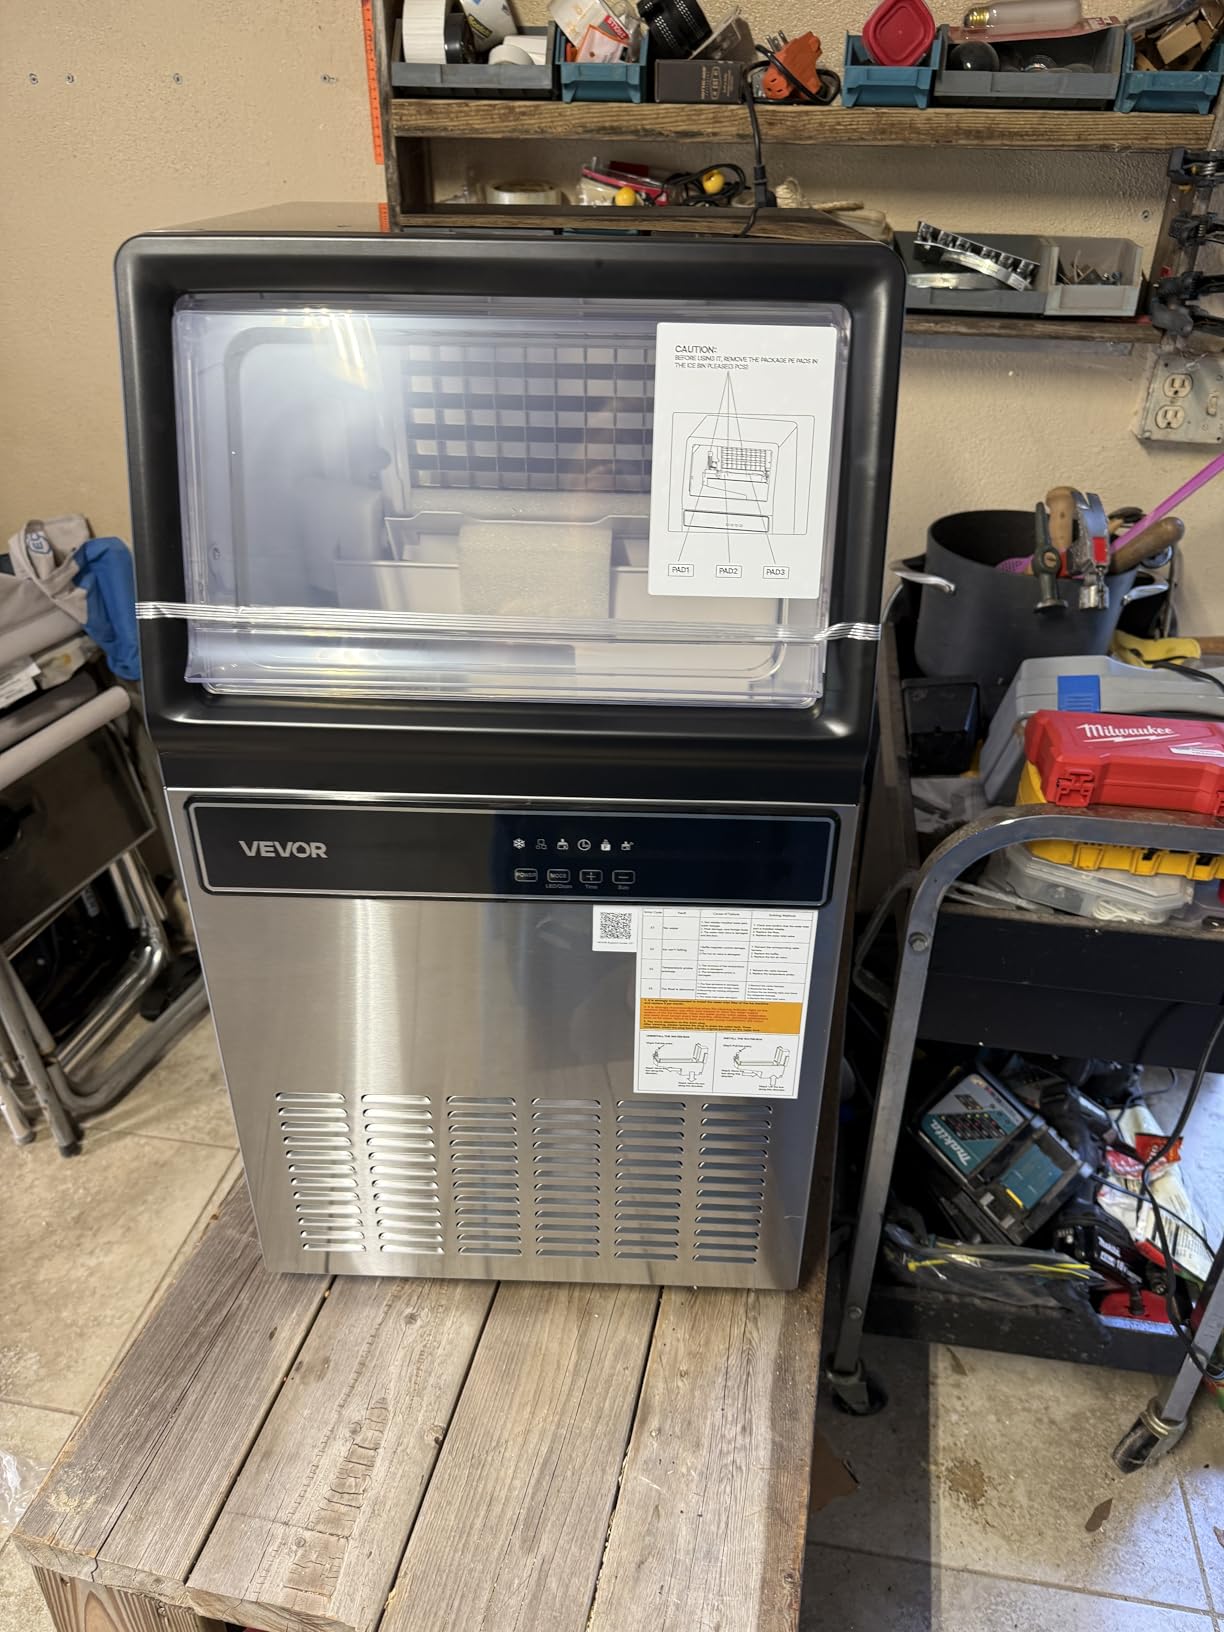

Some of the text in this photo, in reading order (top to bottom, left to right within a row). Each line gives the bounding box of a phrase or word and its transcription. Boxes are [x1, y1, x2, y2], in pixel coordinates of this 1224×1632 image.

[675, 345, 717, 354] CAUTION:
[719, 567, 738, 575] PAD2
[766, 568, 786, 576] PAD3
[1077, 723, 1175, 738] Milwaukee
[239, 840, 329, 858] VEVOR
